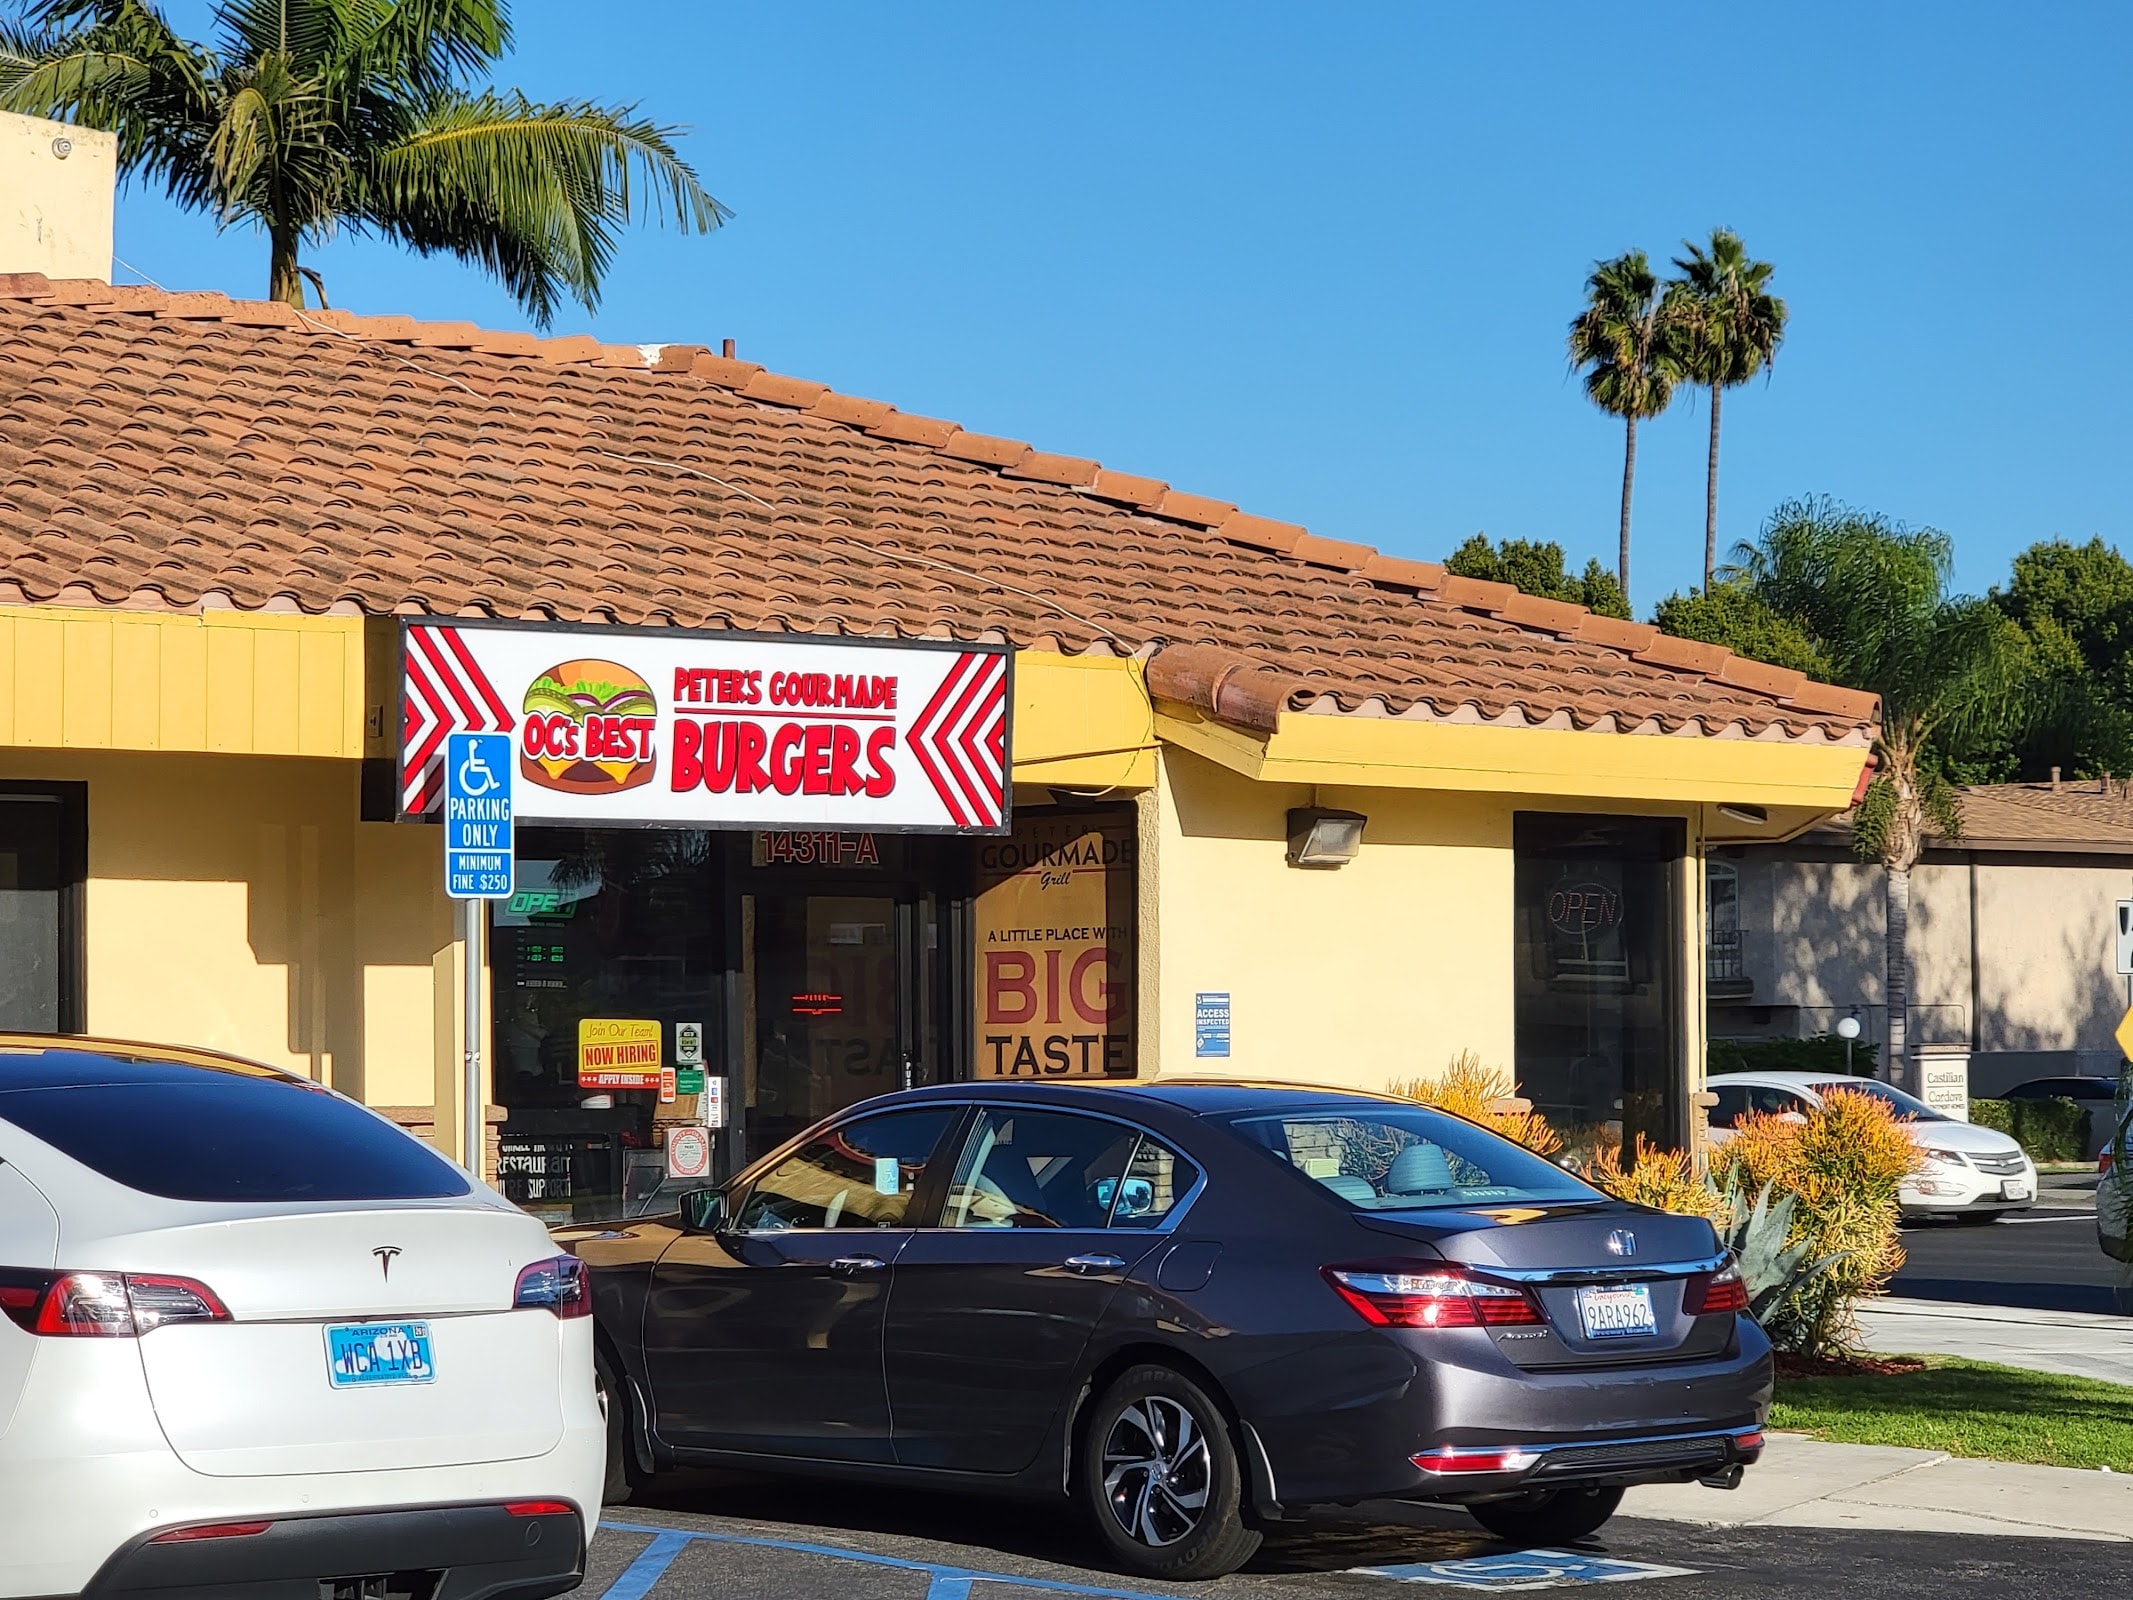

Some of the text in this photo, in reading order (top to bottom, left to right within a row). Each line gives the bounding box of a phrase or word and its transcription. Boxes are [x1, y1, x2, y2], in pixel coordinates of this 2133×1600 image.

[674, 667, 898, 709] PETER'S GOURMADE
[585, 716, 656, 759] BEST
[671, 719, 896, 798] BURGERS
[450, 797, 510, 821] PARKING
[462, 823, 498, 846] ONLY
[760, 832, 879, 864] 14311-A
[981, 838, 1133, 869] GOURMADE
[459, 855, 501, 870] MINIMUM
[453, 873, 508, 891] FINE $250
[1041, 871, 1071, 891] Grill
[1549, 892, 1617, 925] OPEN
[988, 926, 1127, 942] A LITTLE PLACE WITH
[985, 947, 1128, 1024] BIG
[1197, 1009, 1229, 1018] ACCESS
[586, 1023, 654, 1038] Join Our Team!
[586, 1044, 656, 1066] NOW HIRING
[986, 1033, 1129, 1075] TASTE
[1588, 1303, 1650, 1329] 9ARA962
[352, 1327, 405, 1337] ARIZONA
[387, 1339, 423, 1371] 1XB
